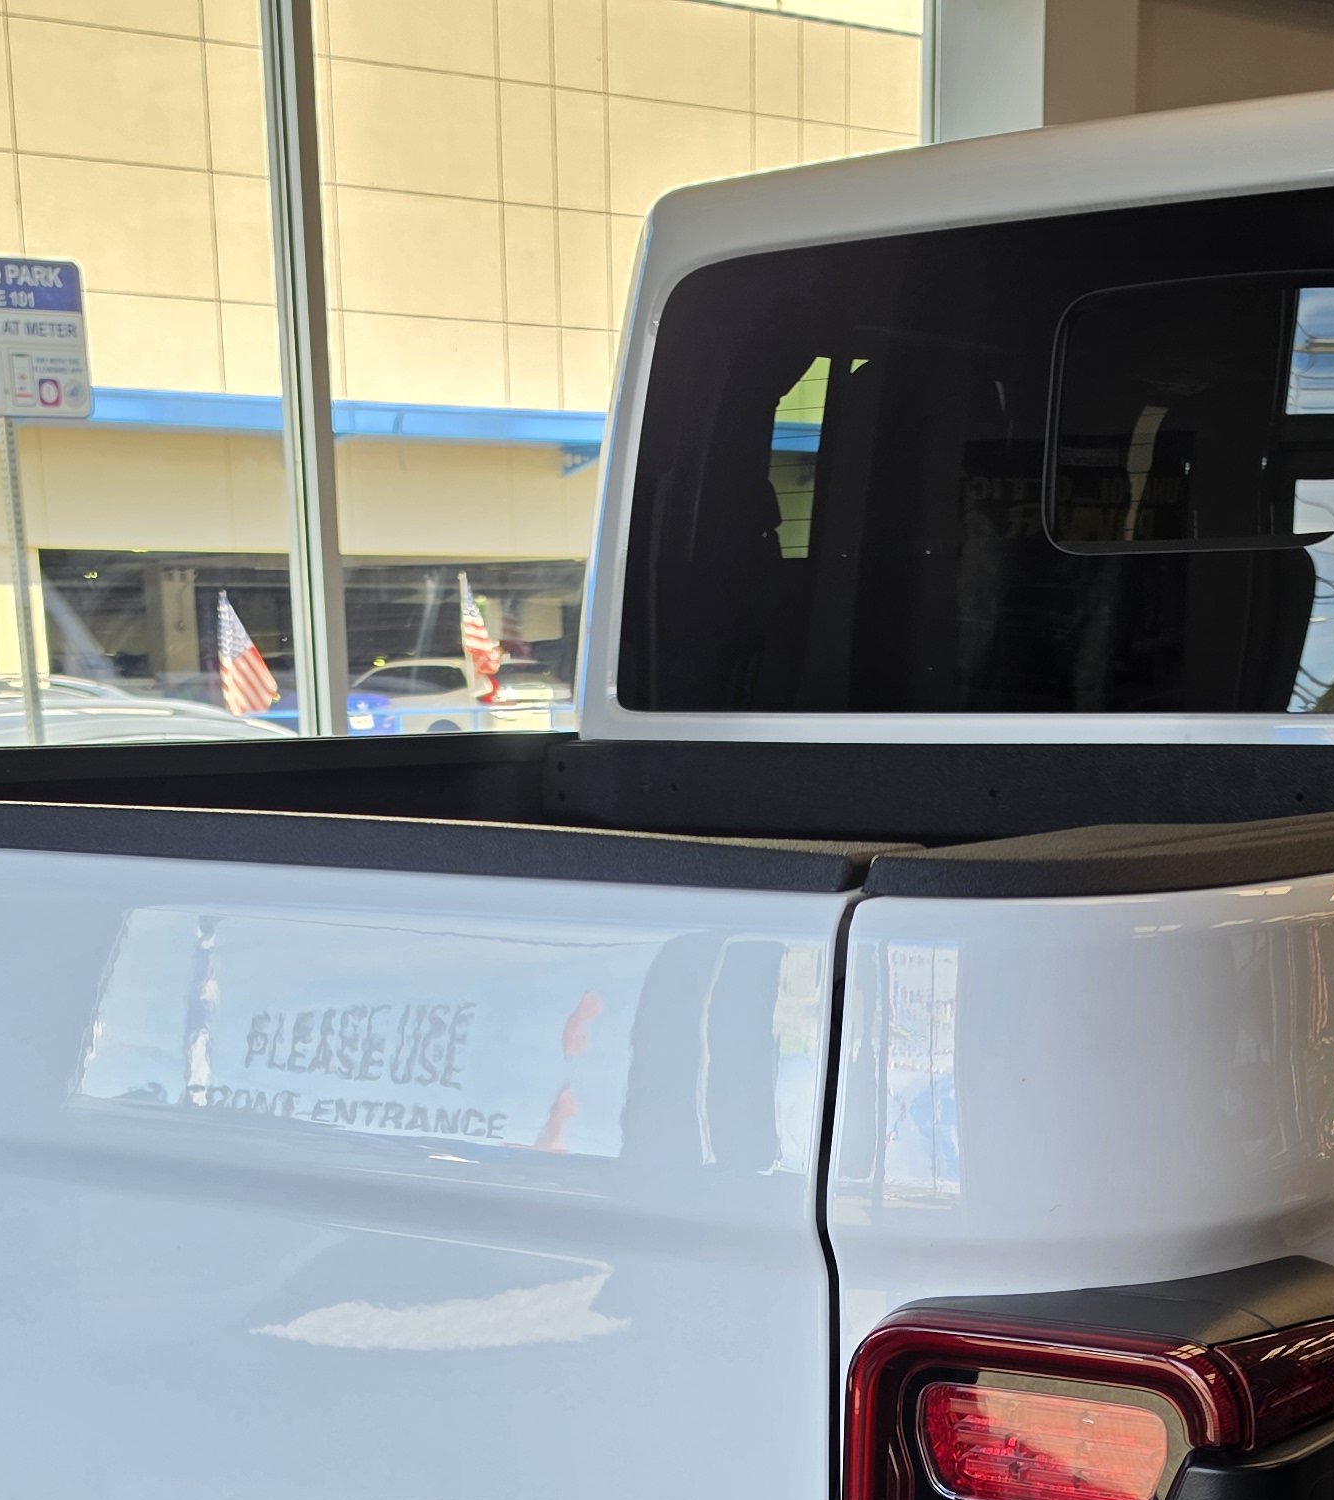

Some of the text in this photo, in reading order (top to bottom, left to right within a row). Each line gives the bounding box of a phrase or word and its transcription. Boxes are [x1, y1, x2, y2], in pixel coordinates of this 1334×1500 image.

[4, 264, 64, 289] PARK
[9, 290, 35, 308] 101
[2, 319, 20, 335] AT
[26, 321, 78, 338] METER
[310, 1097, 508, 1140] ENTRANCE
